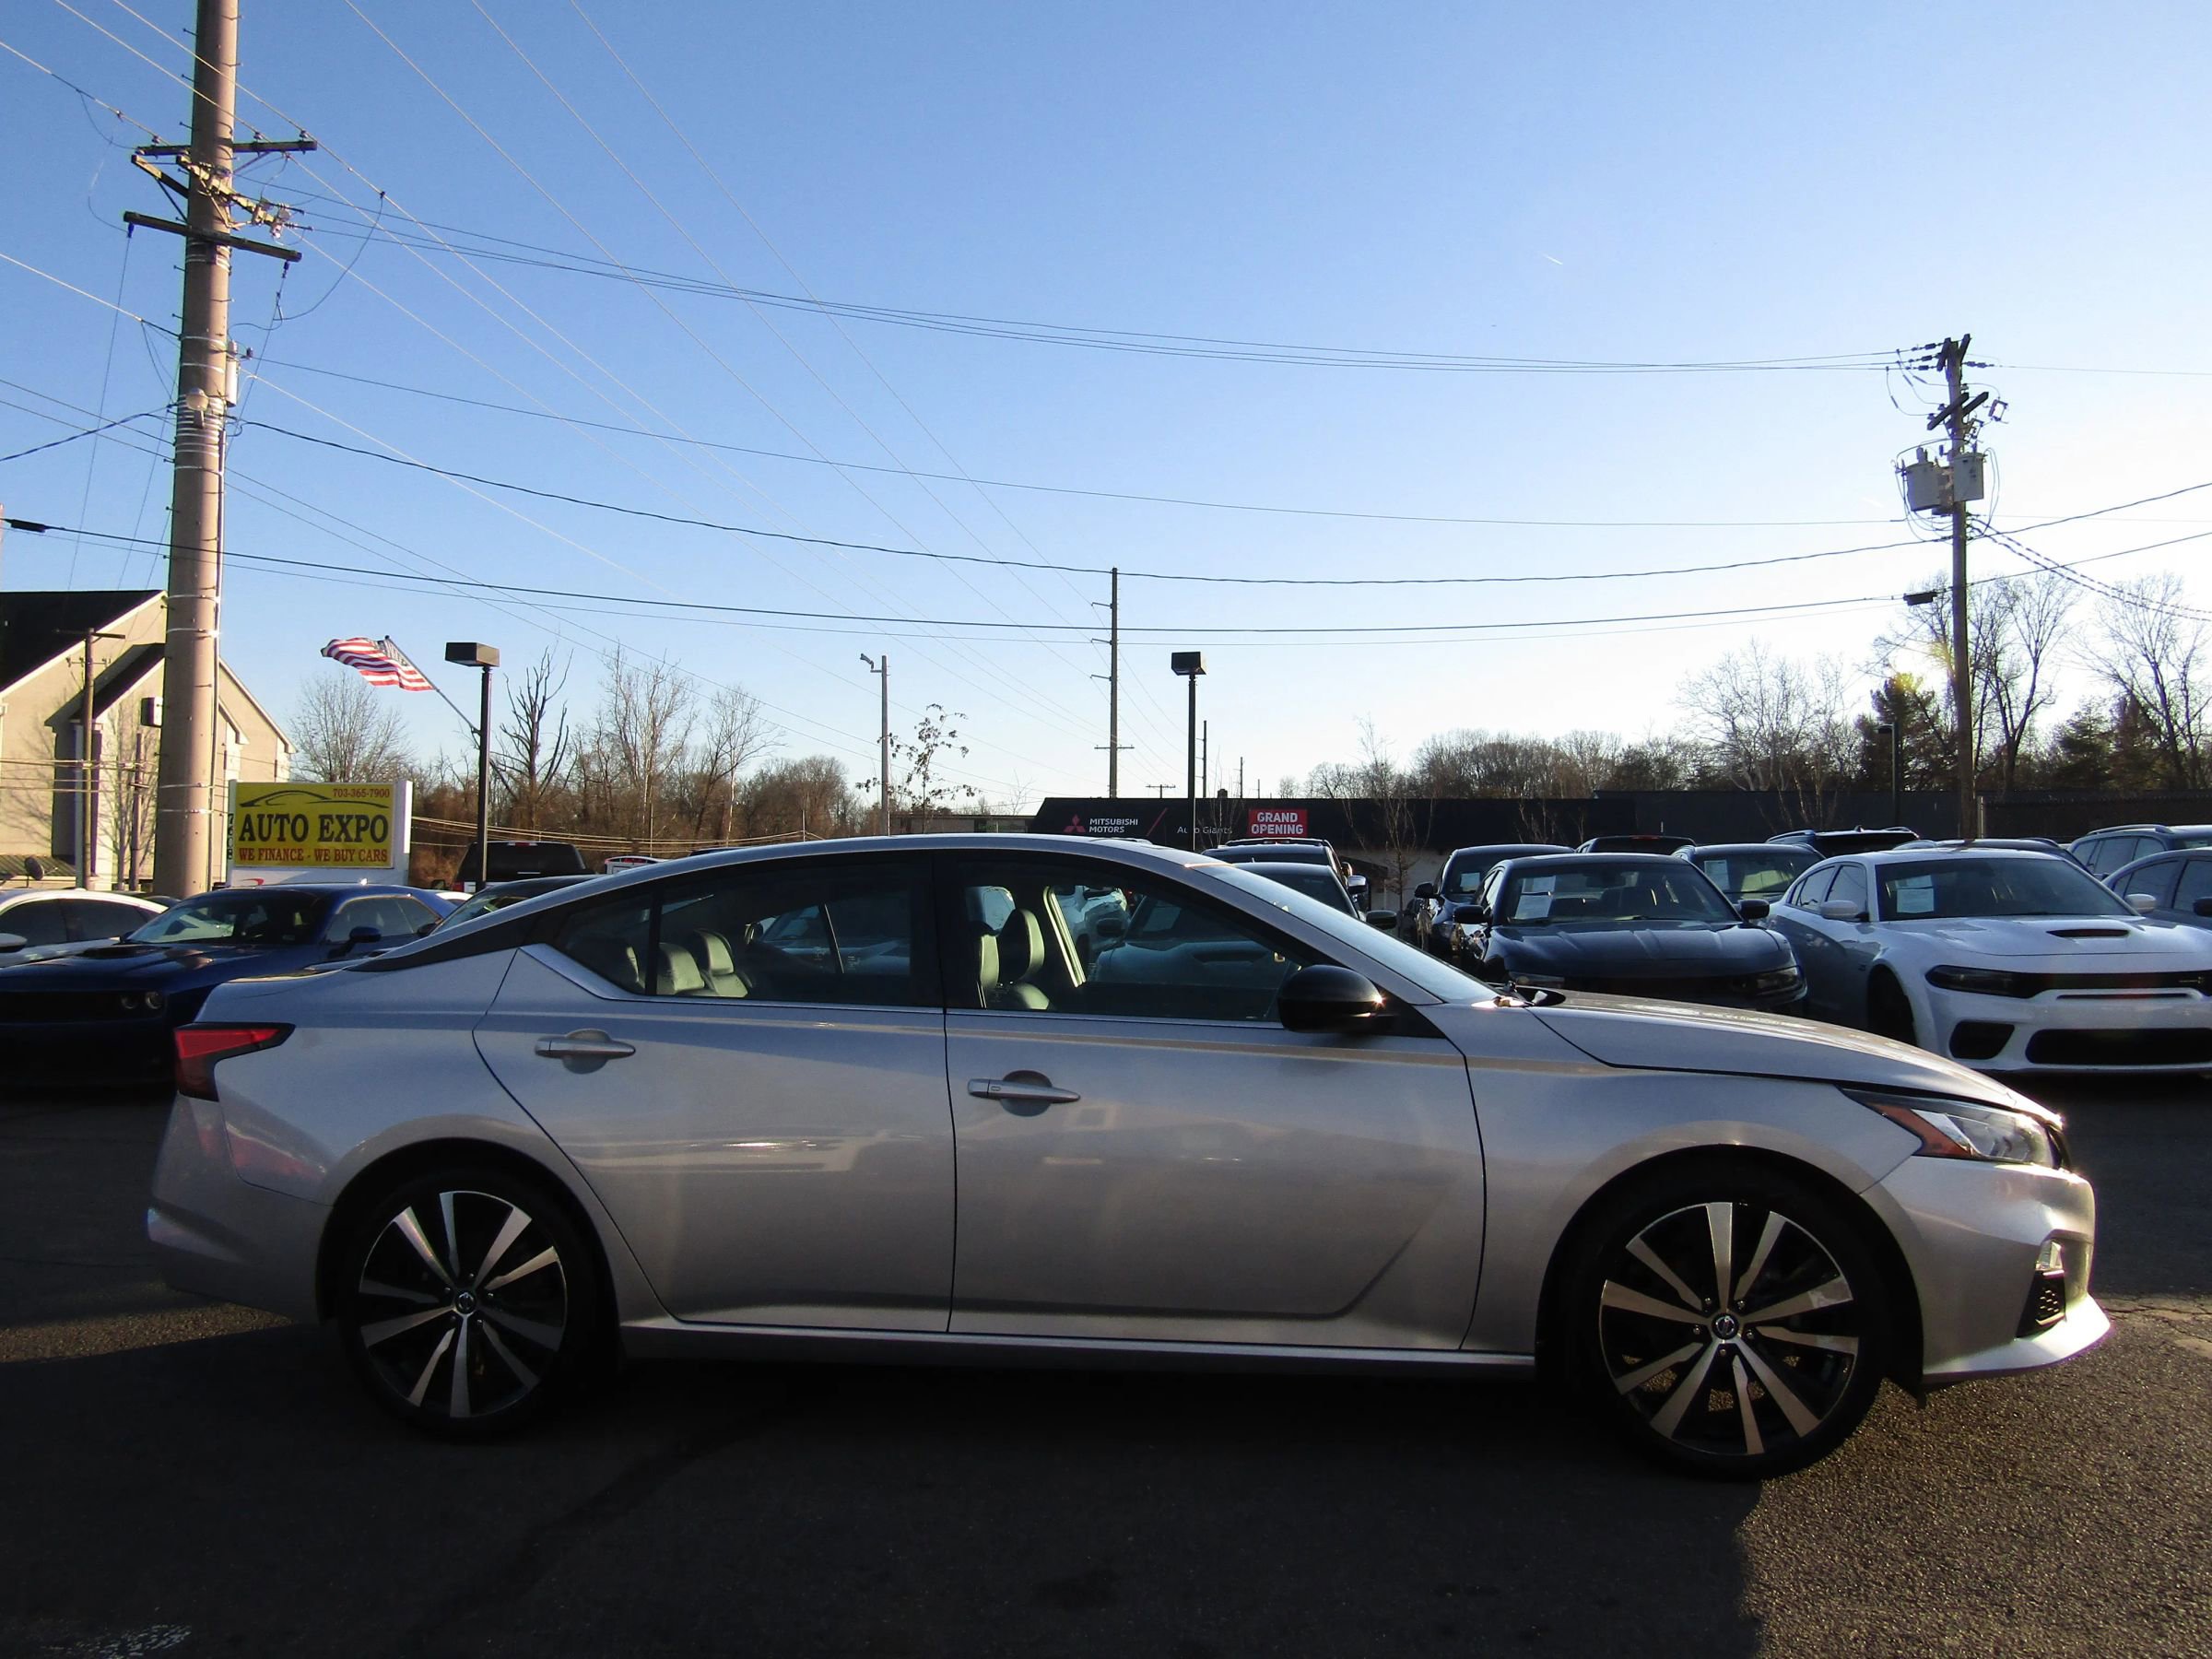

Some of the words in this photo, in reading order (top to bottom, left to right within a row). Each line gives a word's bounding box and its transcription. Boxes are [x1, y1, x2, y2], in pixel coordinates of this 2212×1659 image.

[333, 788, 390, 798] 703-365-7900
[1089, 818, 1138, 826] MITSUBISHI
[1256, 812, 1299, 823] GRAND
[239, 814, 309, 842] AUTO
[318, 814, 389, 843] EXPO
[1251, 823, 1304, 835] OPENING
[239, 848, 255, 861] WE
[257, 848, 304, 862] FINANCE
[313, 848, 331, 862] WE
[334, 848, 356, 862] BUY
[358, 848, 388, 862] CARS
